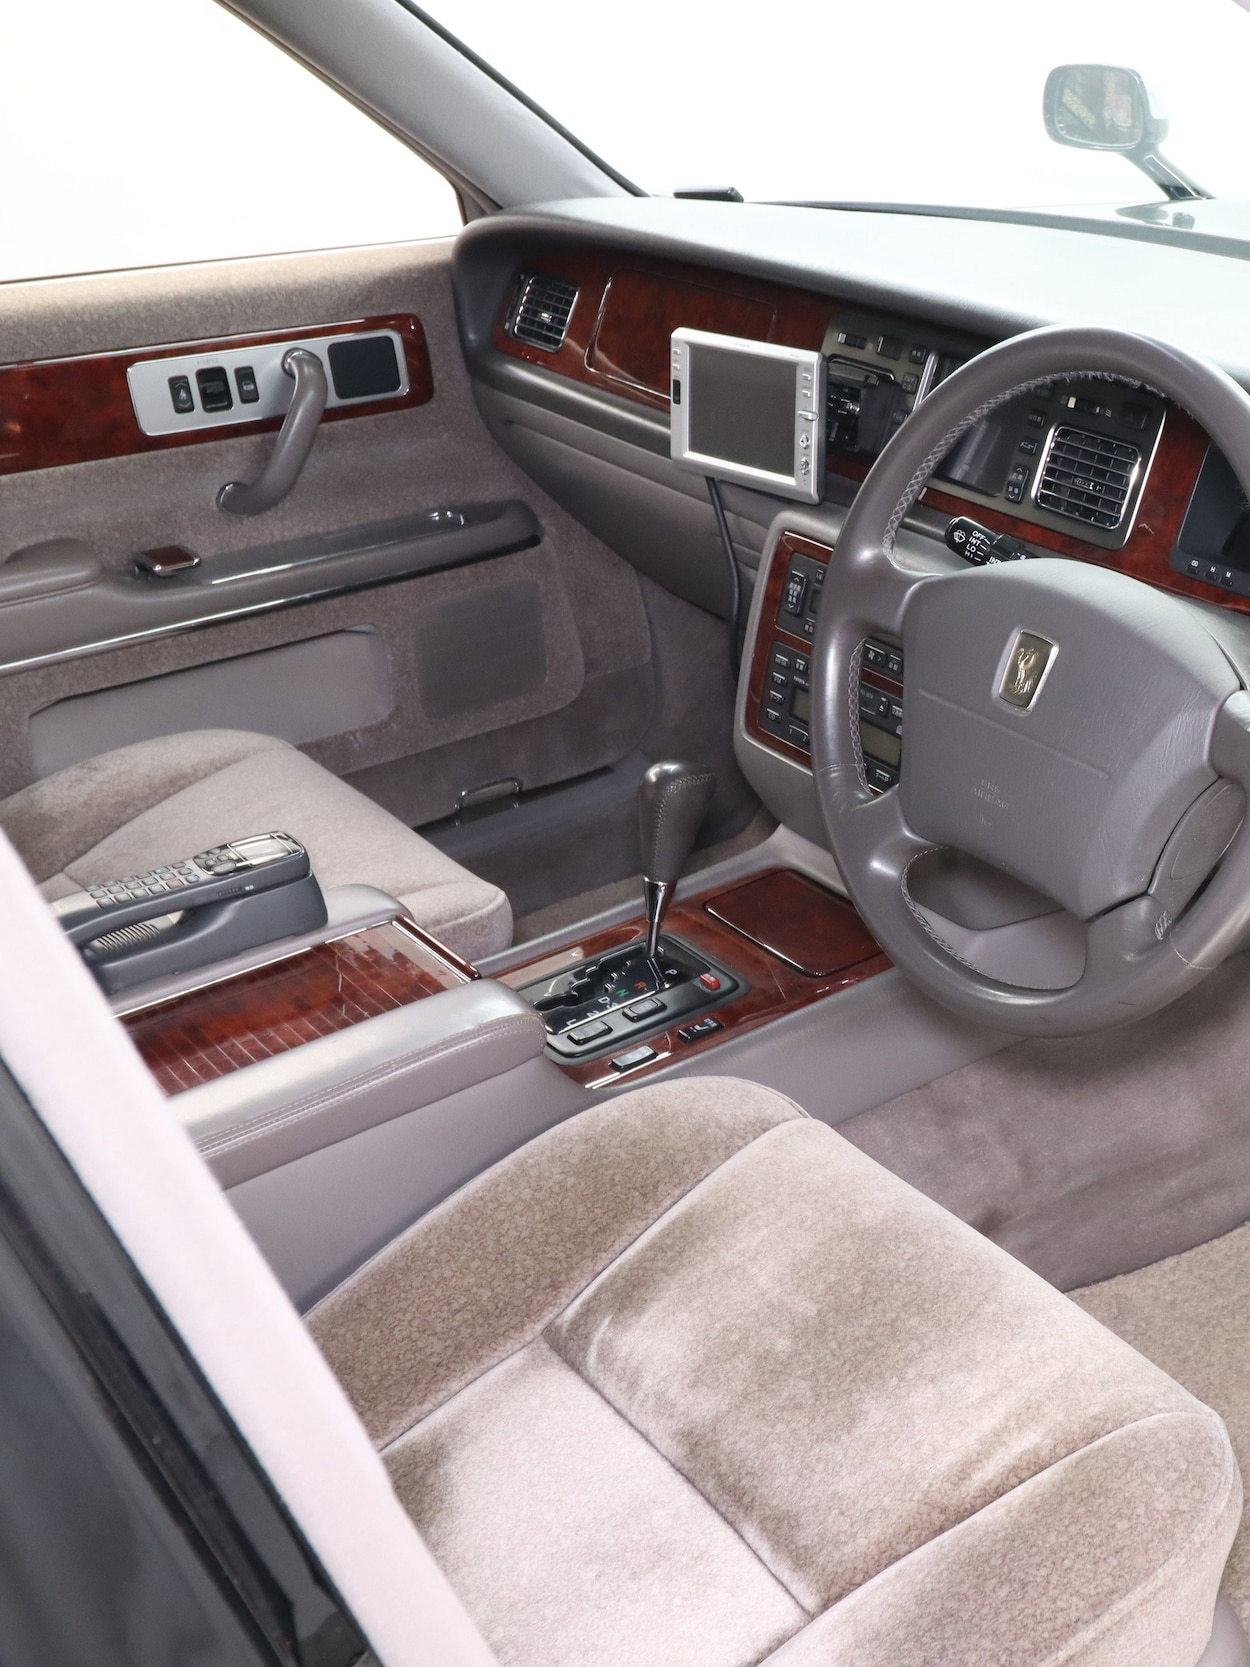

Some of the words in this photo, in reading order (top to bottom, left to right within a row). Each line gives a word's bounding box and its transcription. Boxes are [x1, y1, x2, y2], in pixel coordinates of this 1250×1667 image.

[972, 530, 985, 540] OFF
[968, 537, 981, 547] INT
[966, 543, 976, 552] LO
[1209, 565, 1216, 573] H
[665, 968, 678, 976] P
[634, 981, 647, 990] R
[616, 989, 630, 999] N
